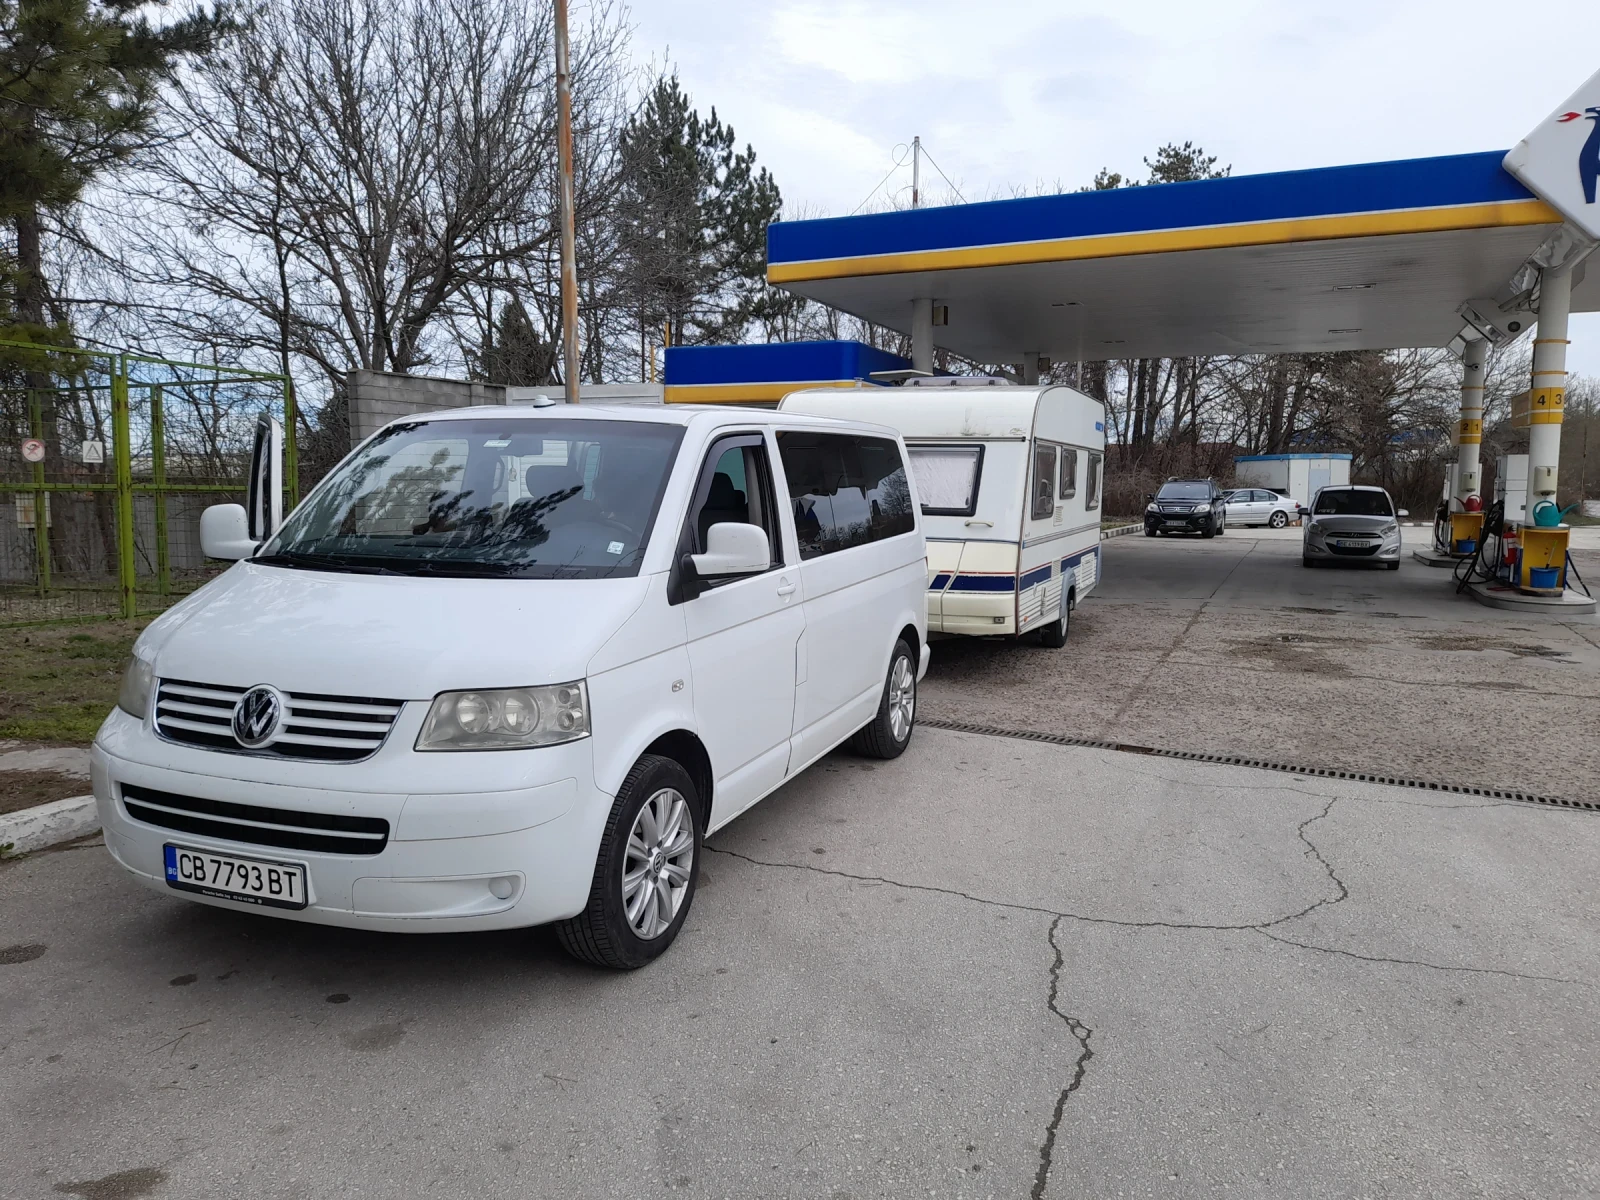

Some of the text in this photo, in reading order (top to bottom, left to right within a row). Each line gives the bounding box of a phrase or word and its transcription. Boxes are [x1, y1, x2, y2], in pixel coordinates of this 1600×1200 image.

[1537, 394, 1562, 405] 4 3
[1463, 423, 1469, 431] 2
